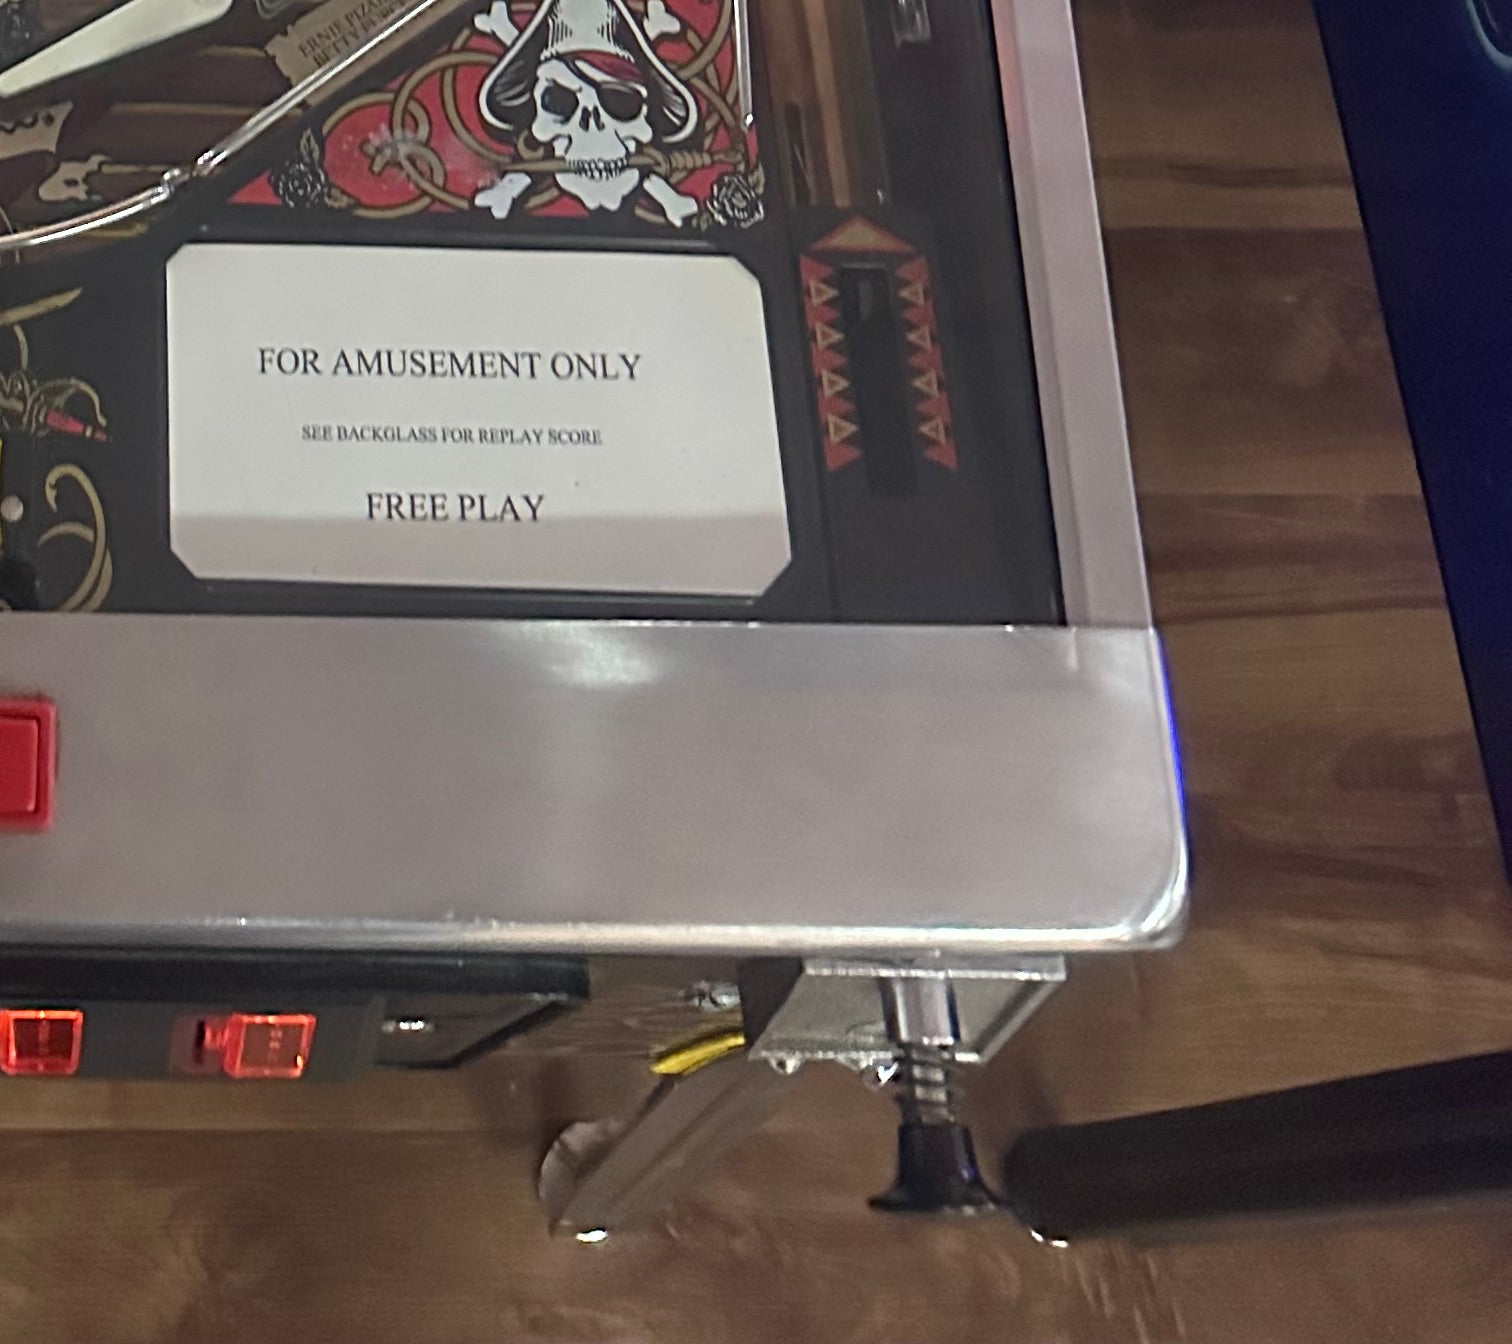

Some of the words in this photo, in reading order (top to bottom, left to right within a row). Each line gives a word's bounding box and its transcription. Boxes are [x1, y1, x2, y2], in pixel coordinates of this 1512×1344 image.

[298, 18, 349, 57] ERNIE
[257, 347, 321, 377] FOR
[331, 349, 542, 380] AMUSEMENT
[550, 351, 645, 382] ONLY
[301, 425, 333, 444] SEE
[336, 425, 438, 445] BACKGLASS
[441, 426, 475, 446] FOR
[478, 427, 544, 447] REPLAY
[547, 428, 604, 447] SCORE
[365, 493, 448, 523] FREE
[457, 493, 546, 524] PLAY
